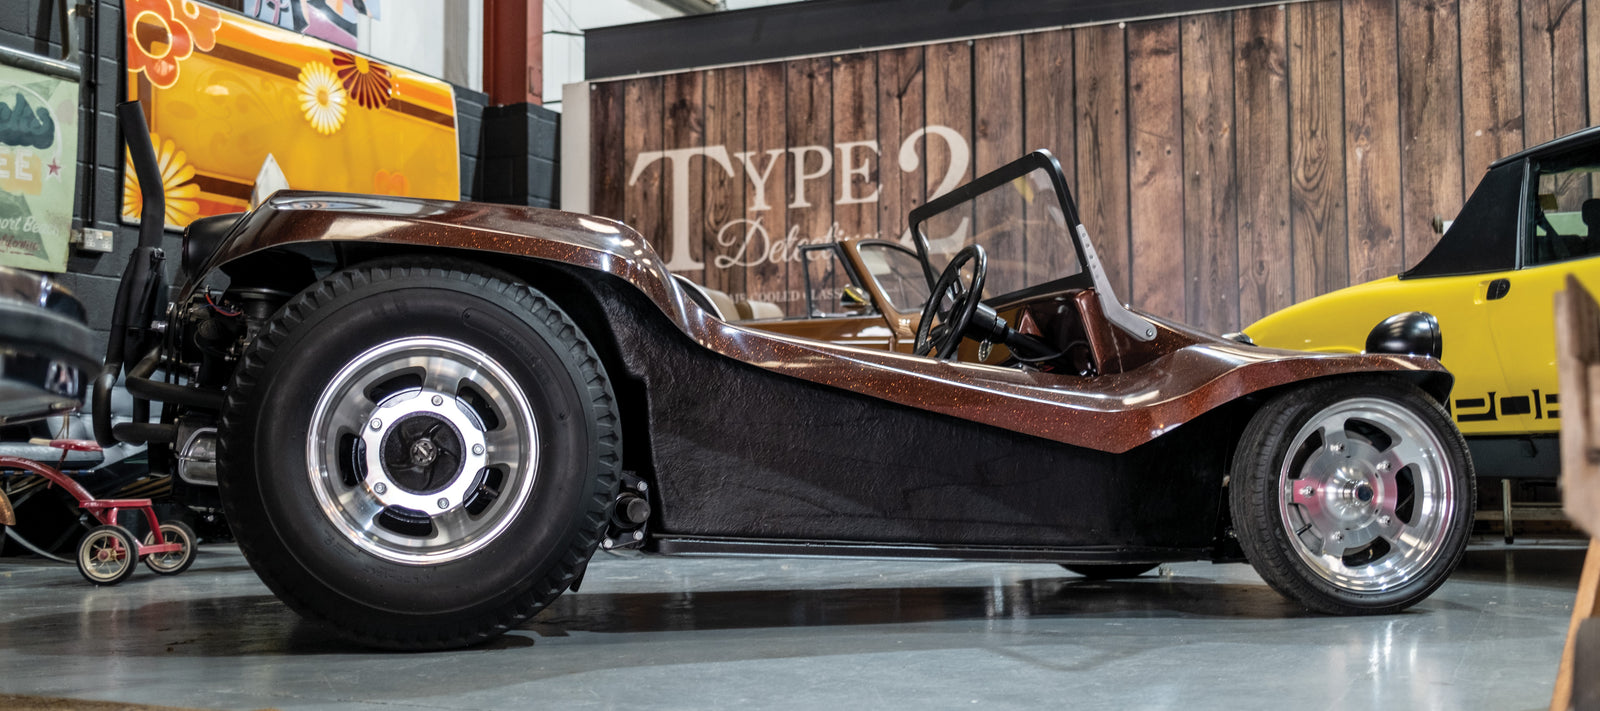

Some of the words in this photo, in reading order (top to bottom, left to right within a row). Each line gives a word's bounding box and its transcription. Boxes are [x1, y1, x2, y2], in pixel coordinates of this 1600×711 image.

[628, 139, 883, 272] TYPE
[898, 125, 970, 255] 2
[714, 217, 883, 270] Detecti
